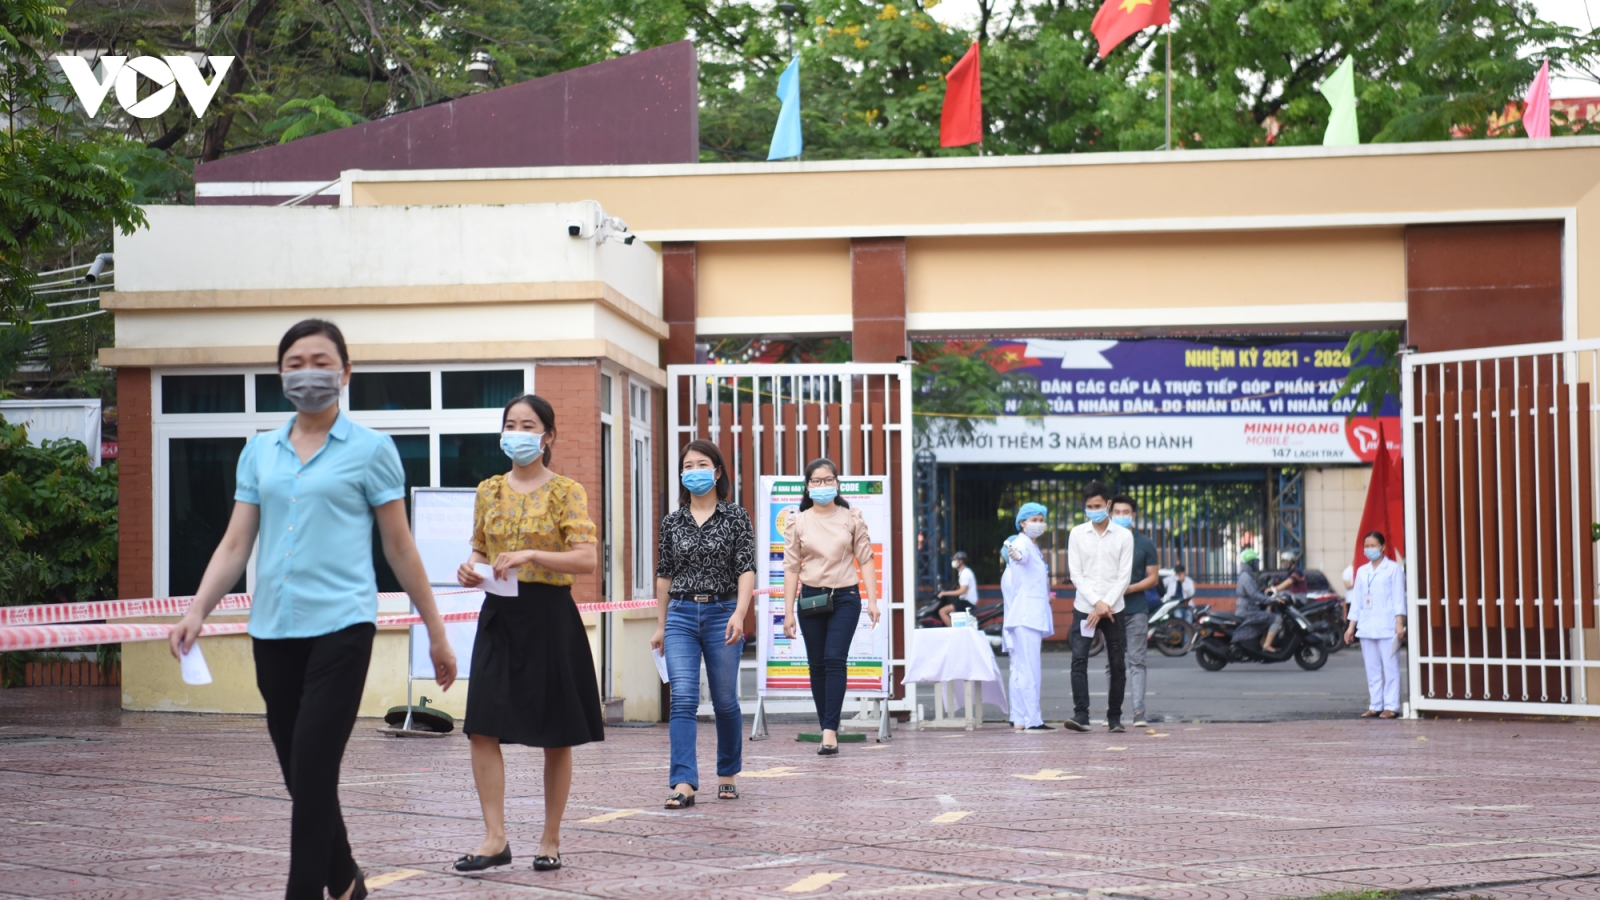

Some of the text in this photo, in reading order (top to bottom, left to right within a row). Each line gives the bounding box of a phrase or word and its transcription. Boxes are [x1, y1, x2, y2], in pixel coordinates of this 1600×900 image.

[1185, 346, 1235, 370] NHIỆM
[1262, 350, 1298, 368] 2021
[1041, 378, 1073, 394] DÂN
[1076, 378, 1106, 394] CÁC
[1109, 377, 1140, 394] CẤP
[1143, 378, 1162, 394] LÀ
[1164, 379, 1203, 396] TRỰC
[1206, 378, 1238, 394] TIẾP
[1241, 379, 1271, 394] GÓP
[1078, 397, 1120, 412] NHÂN
[1123, 397, 1158, 414] DÂN,
[1162, 399, 1183, 412] DO
[1186, 397, 1227, 412] NHÂN
[1231, 397, 1266, 414] DÂN,
[1269, 396, 1284, 412] VÌ
[1287, 396, 1329, 412] NHÂN
[1244, 422, 1340, 434] MINH HOANG
[998, 432, 1043, 449] THÊM
[1048, 432, 1060, 449] 3
[1066, 433, 1103, 449] NĂM
[1108, 432, 1141, 449] BẢO
[1146, 432, 1193, 449] HÀNH
[1246, 436, 1289, 446] MOBILE
[1272, 448, 1291, 458] 147
[1321, 450, 1344, 458] TRAY
[840, 482, 860, 492] CODE
